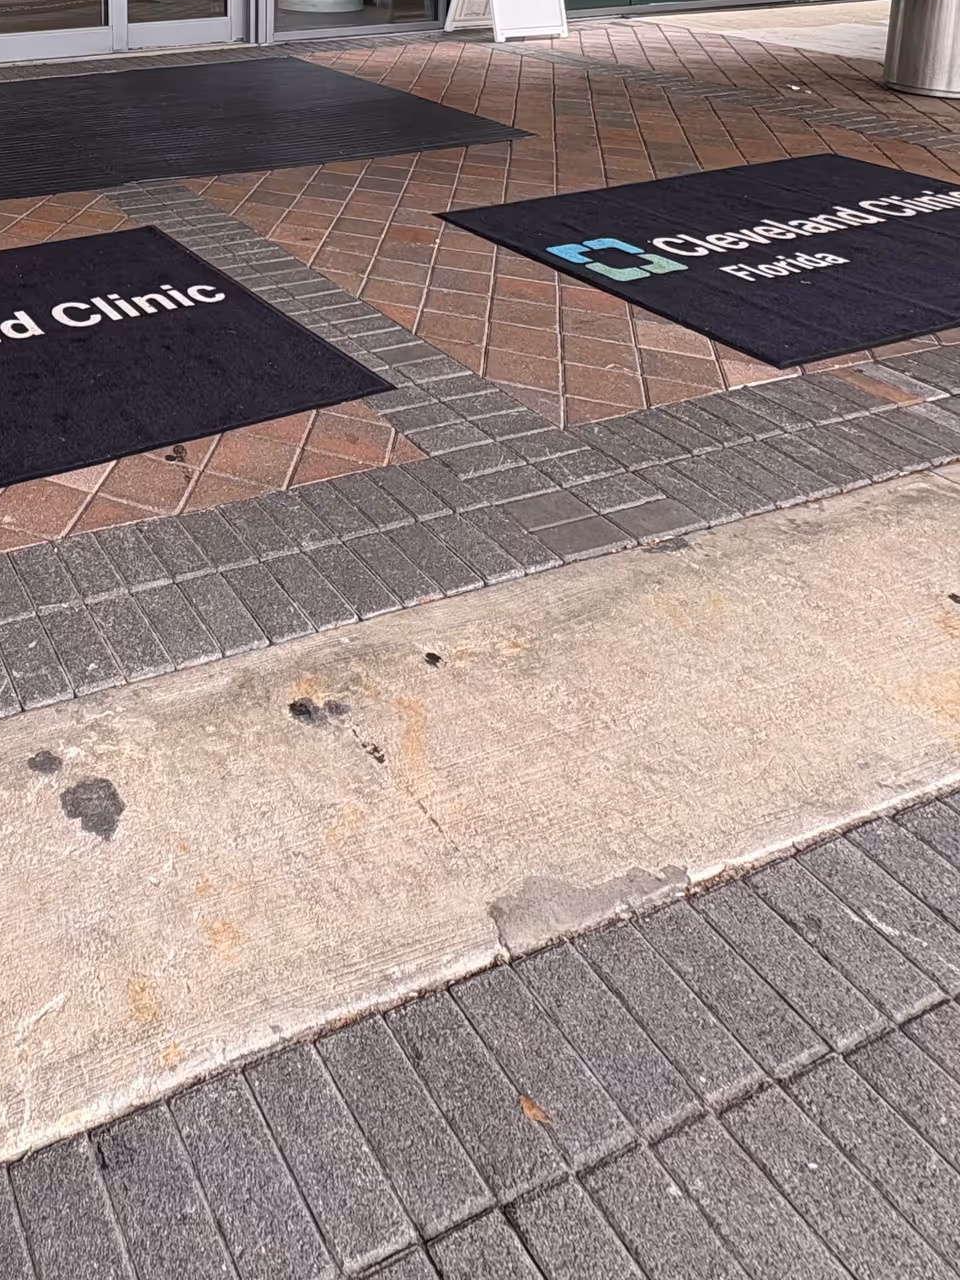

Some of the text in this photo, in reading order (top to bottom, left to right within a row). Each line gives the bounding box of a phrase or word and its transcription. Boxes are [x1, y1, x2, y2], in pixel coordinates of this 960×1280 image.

[652, 206, 887, 257] Cleveland
[719, 252, 850, 282] Florida
[51, 284, 226, 327] Clinic
